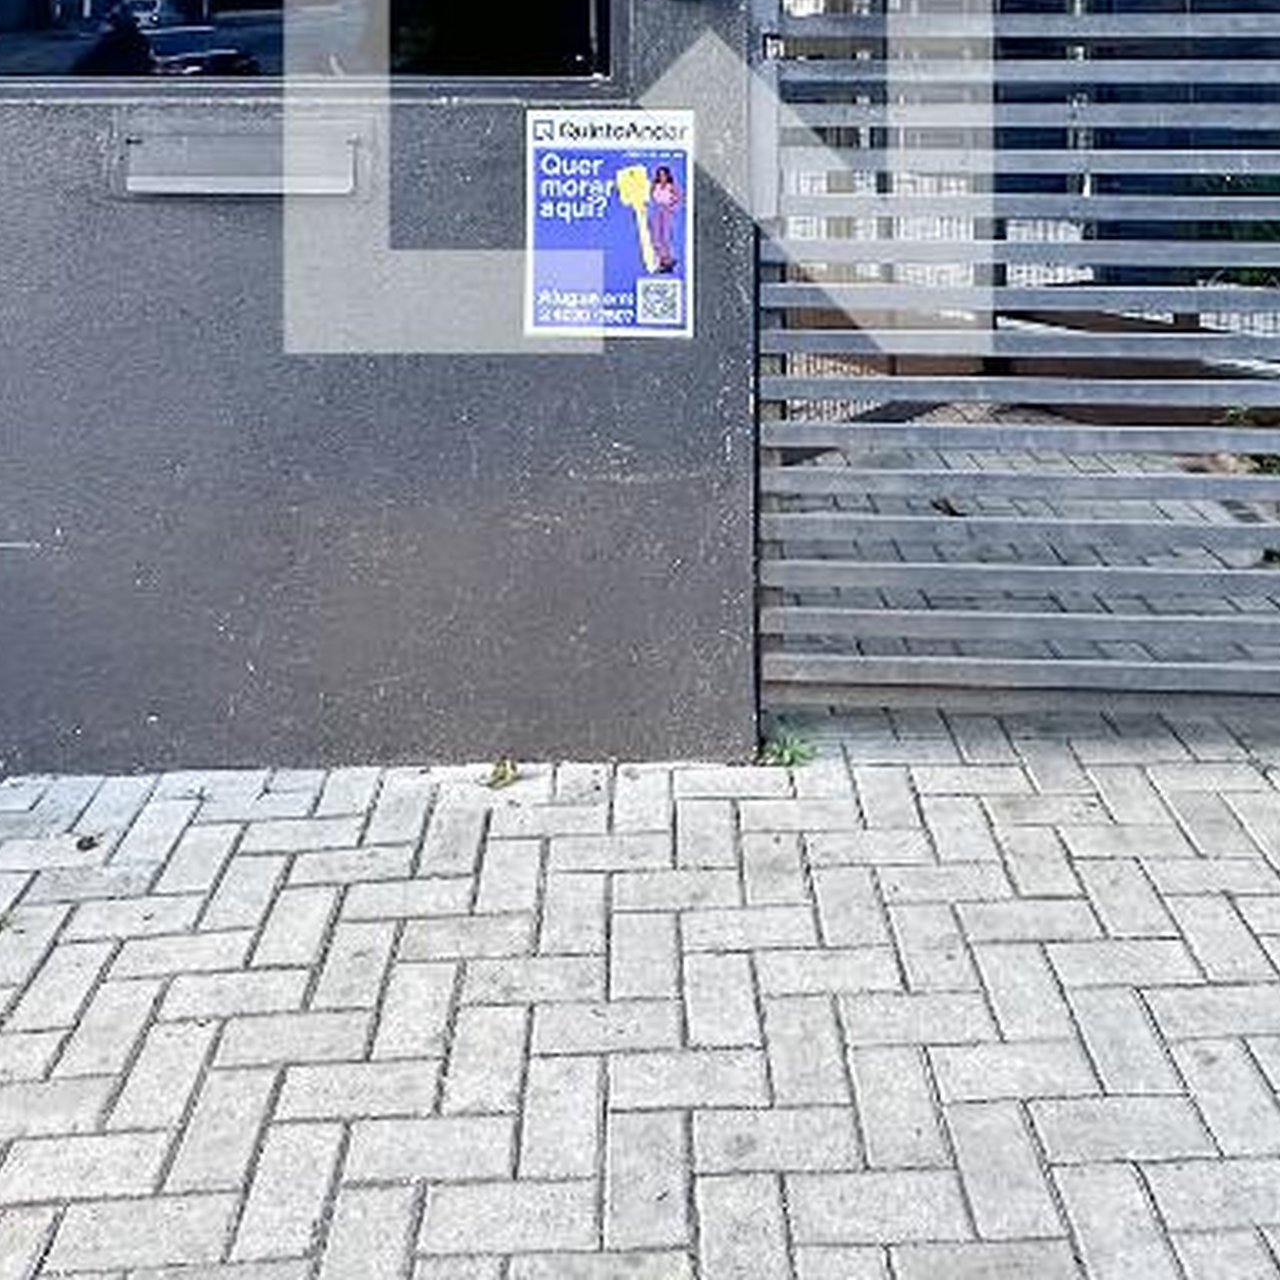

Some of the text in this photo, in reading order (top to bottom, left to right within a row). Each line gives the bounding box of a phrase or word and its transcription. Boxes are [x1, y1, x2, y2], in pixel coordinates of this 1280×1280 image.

[559, 121, 688, 141] QuintoAndar
[540, 153, 604, 177] Quer
[540, 177, 614, 197] morar
[539, 194, 608, 222] aqui?
